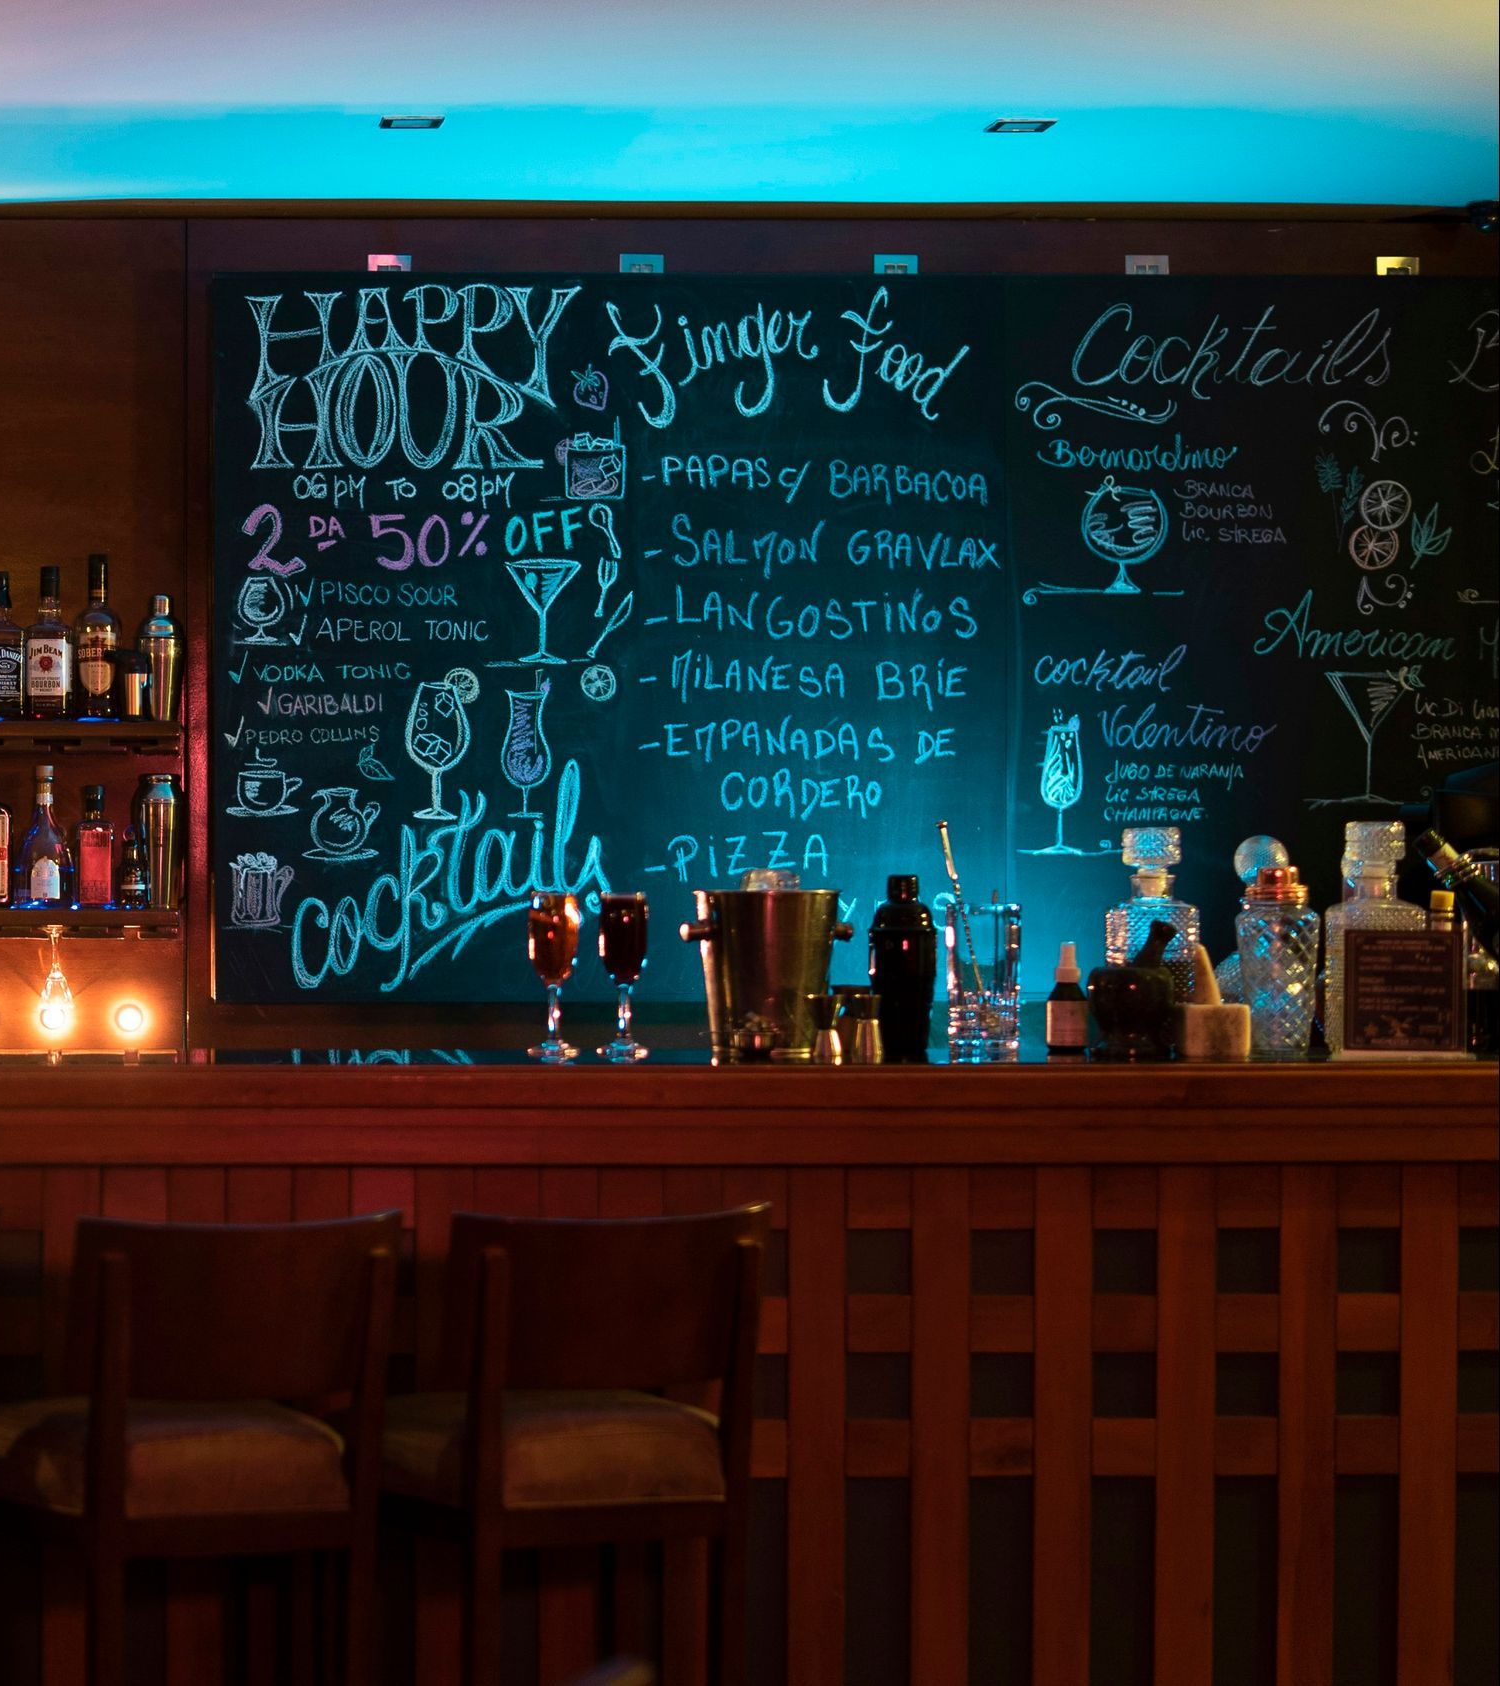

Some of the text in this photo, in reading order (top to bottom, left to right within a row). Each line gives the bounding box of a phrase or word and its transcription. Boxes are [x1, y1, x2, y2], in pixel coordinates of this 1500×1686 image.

[245, 283, 582, 406] HAPPY
[606, 285, 970, 428] Finger Food
[1071, 303, 1391, 399] Cocktails
[246, 350, 545, 470] HOUR
[1037, 433, 1238, 471] Bernardino
[829, 458, 989, 505] BARBACOA
[1173, 479, 1255, 499] BRANCA
[1180, 501, 1274, 521] BOURBON
[369, 511, 490, 571] 50%
[504, 507, 582, 556] OFF
[672, 513, 1001, 580] SALMON GRAVLAX
[320, 582, 458, 606] PISCO SOUR
[316, 619, 490, 642] APEROL TONIC
[1254, 590, 1457, 662] American
[29, 644, 63, 659] JIM BEAM
[252, 663, 411, 682] VODKA TONIC
[276, 692, 383, 715] GARIBALDI
[245, 726, 381, 745] PEDRO COLLINS
[663, 715, 956, 764] EMPANADAS DE
[1411, 722, 1483, 740] BRANCA
[721, 767, 881, 820] CORDERO
[1105, 758, 1244, 791] JUGO DE NARANJA
[667, 831, 830, 882] PIZZA
